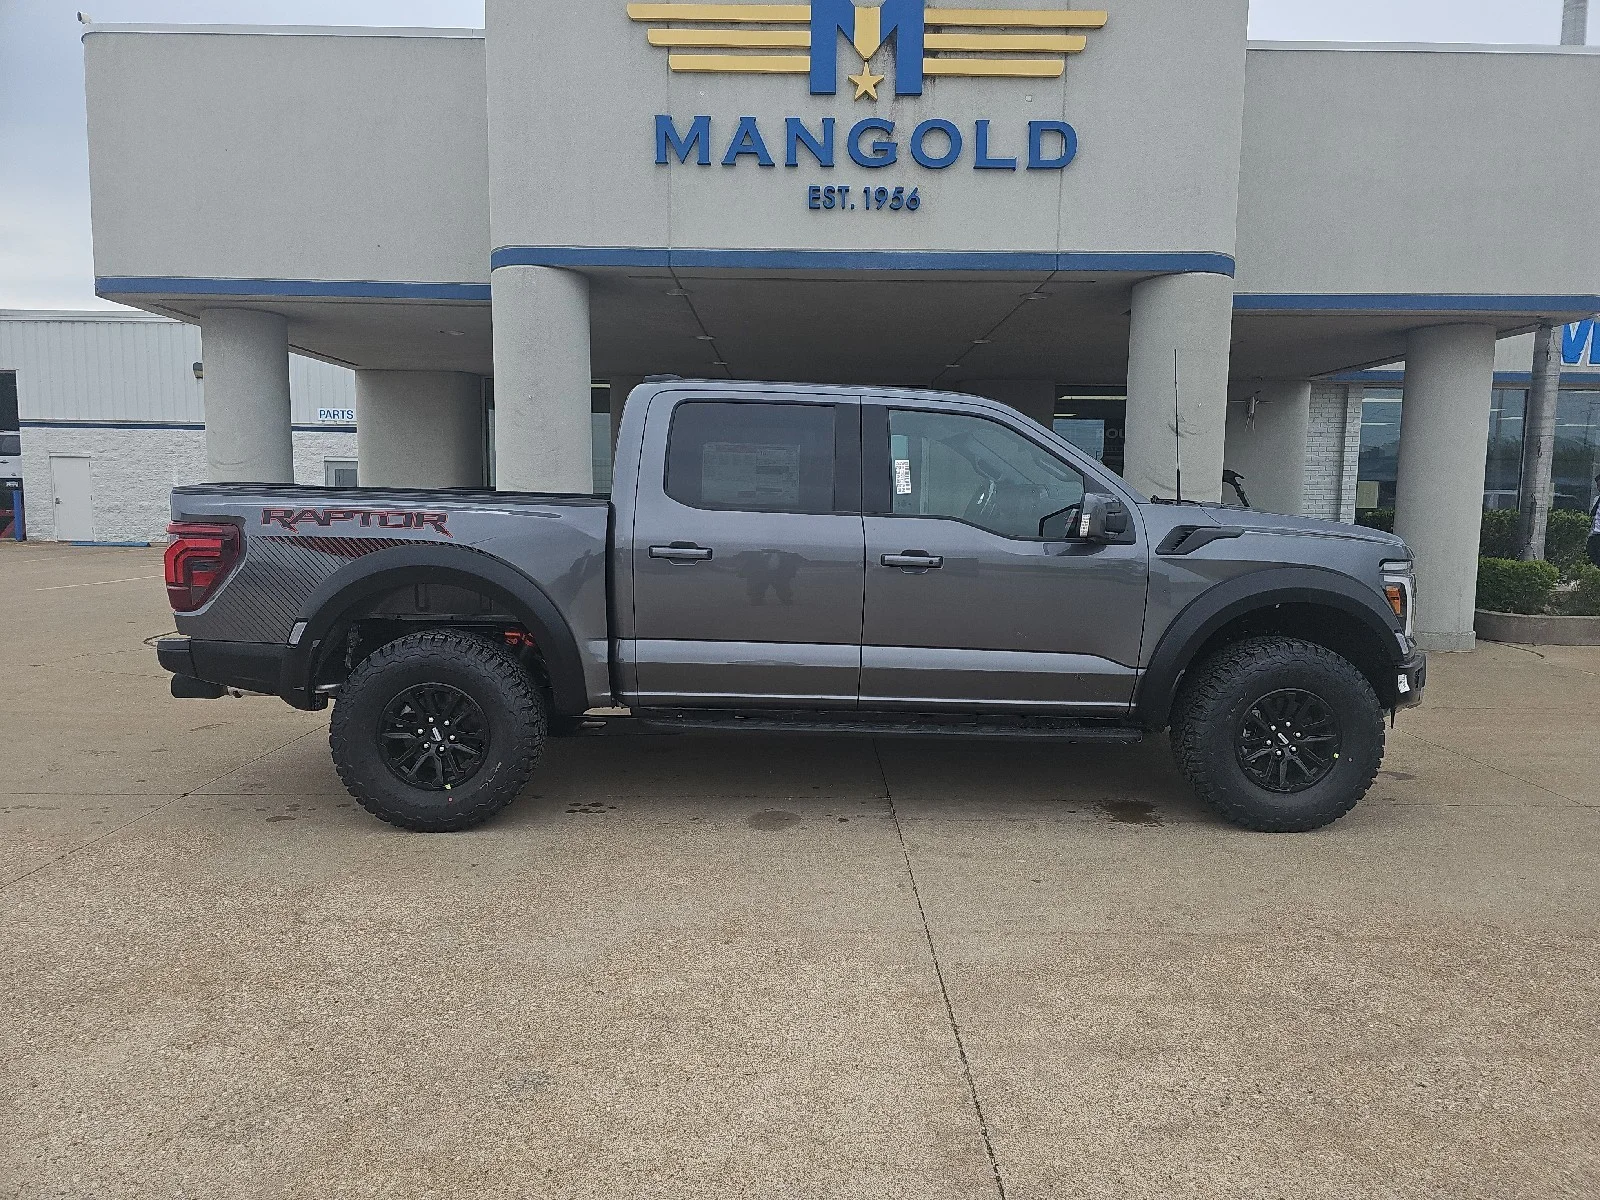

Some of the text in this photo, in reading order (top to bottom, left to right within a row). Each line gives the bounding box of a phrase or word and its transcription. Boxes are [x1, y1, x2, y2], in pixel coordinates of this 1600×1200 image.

[810, 0, 924, 96] M
[654, 113, 1079, 171] MANGOLD
[807, 184, 921, 211] EST. 1956
[319, 409, 354, 420] PARTS
[261, 508, 454, 539] RAPTOR
